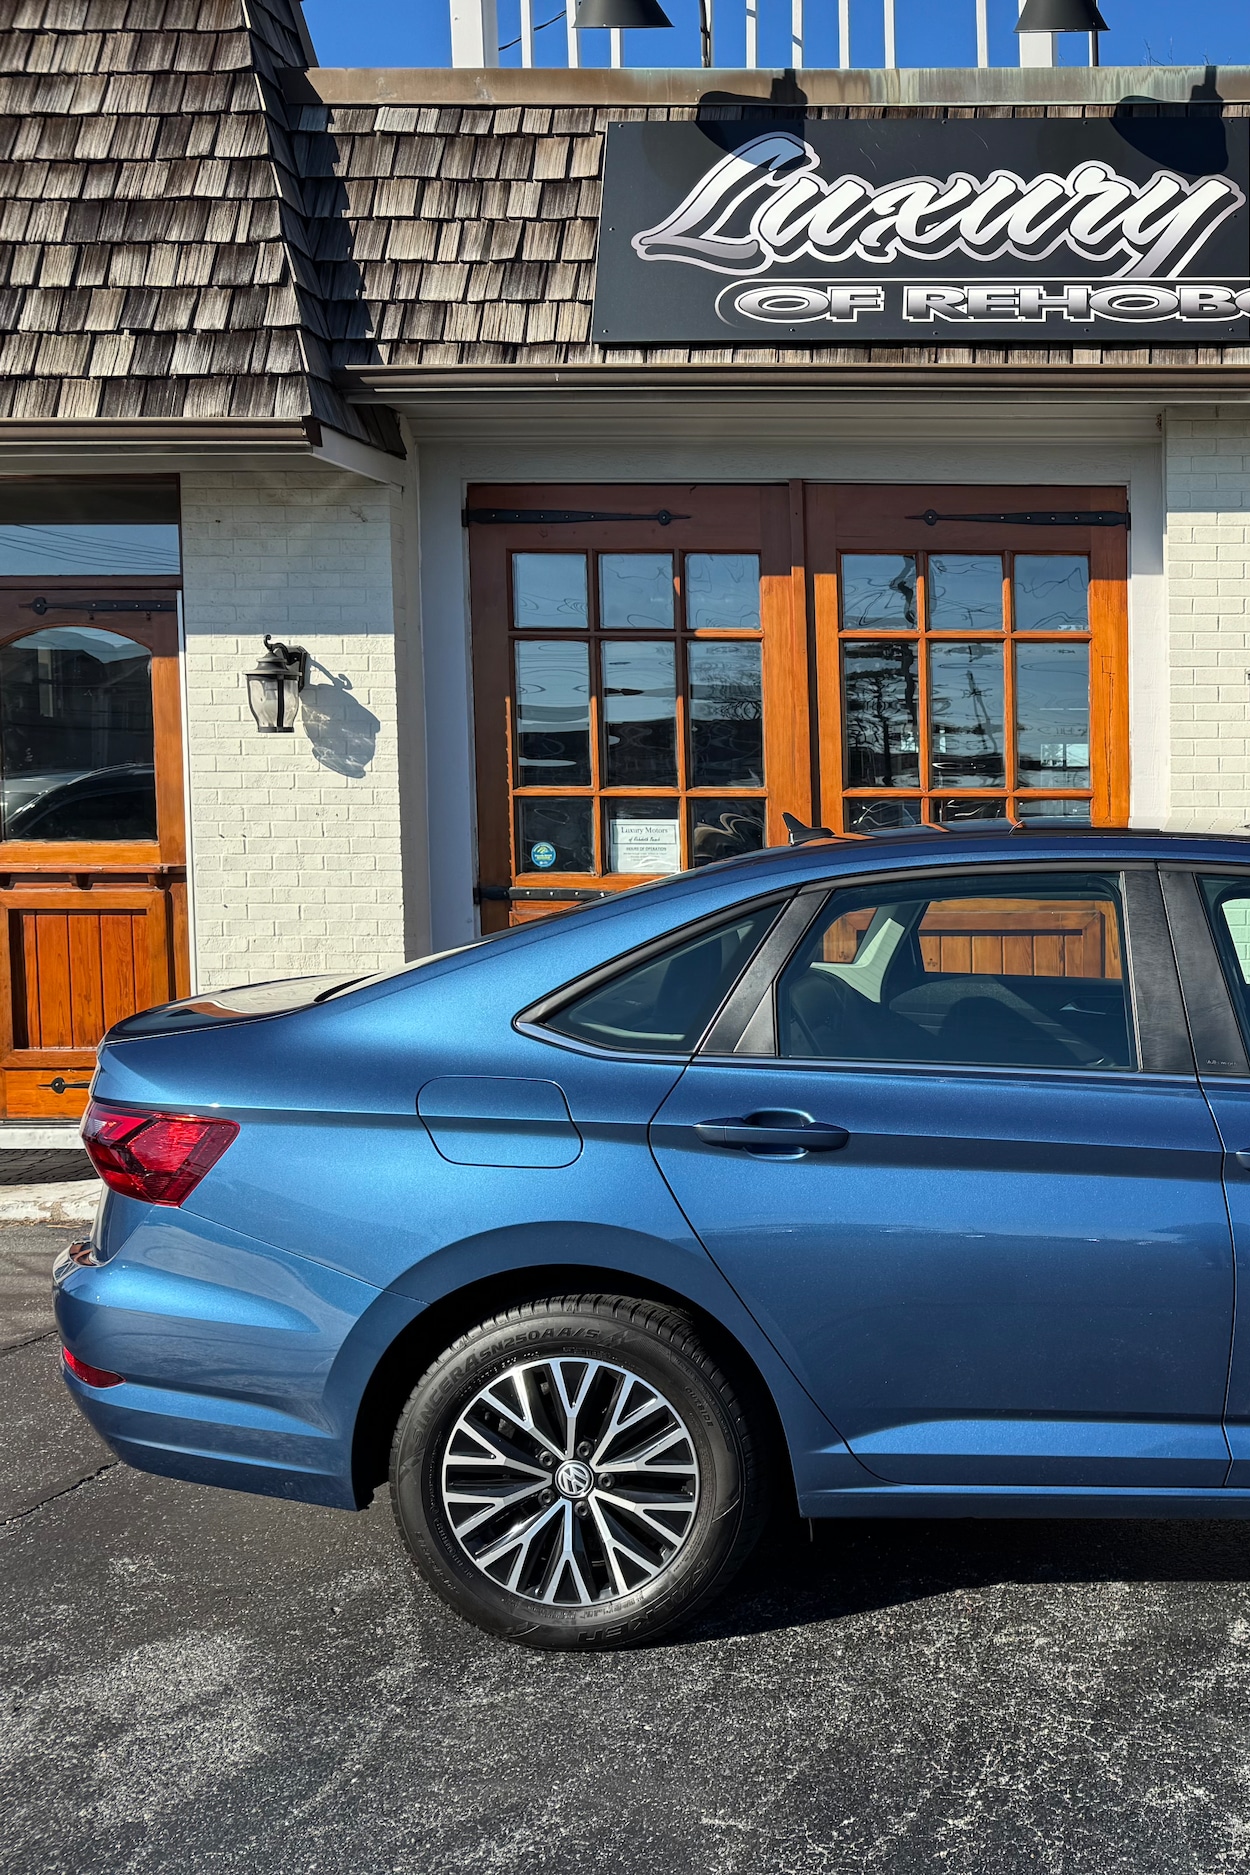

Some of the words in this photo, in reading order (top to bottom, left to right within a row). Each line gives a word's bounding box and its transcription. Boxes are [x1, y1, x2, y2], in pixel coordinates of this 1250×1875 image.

[631, 131, 1246, 279] Luxury
[735, 285, 885, 325] OF
[411, 1351, 482, 1444] SINCERA
